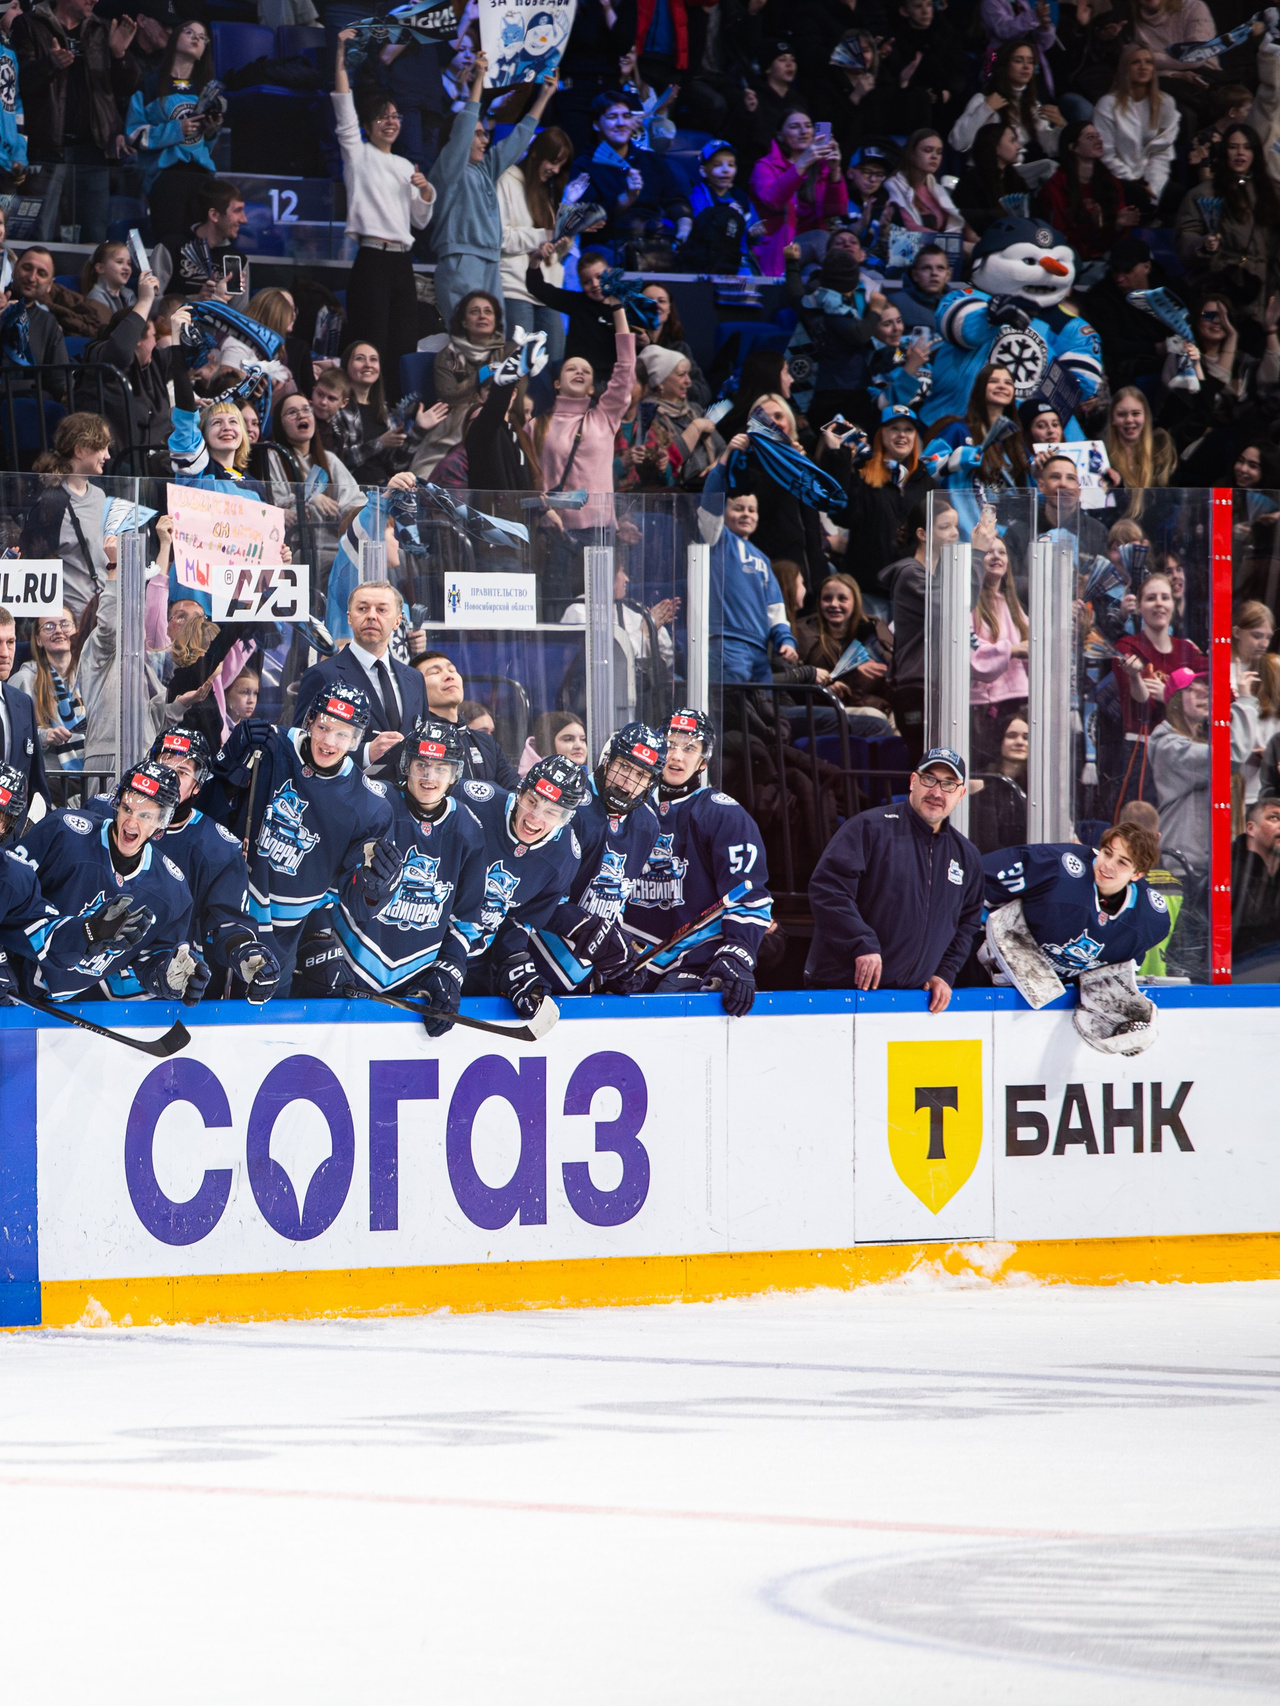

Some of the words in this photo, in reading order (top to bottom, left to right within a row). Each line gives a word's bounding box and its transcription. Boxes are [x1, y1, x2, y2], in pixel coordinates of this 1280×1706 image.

[269, 189, 300, 222] 12
[470, 587, 528, 598] ПРАВИТЕЛЬСТВО
[0, 773, 11, 788] 91
[552, 770, 566, 783] 15
[728, 843, 759, 875] 57
[509, 962, 537, 981] CC
[914, 1086, 959, 1160] Т
[1005, 1081, 1196, 1157] БАНК
